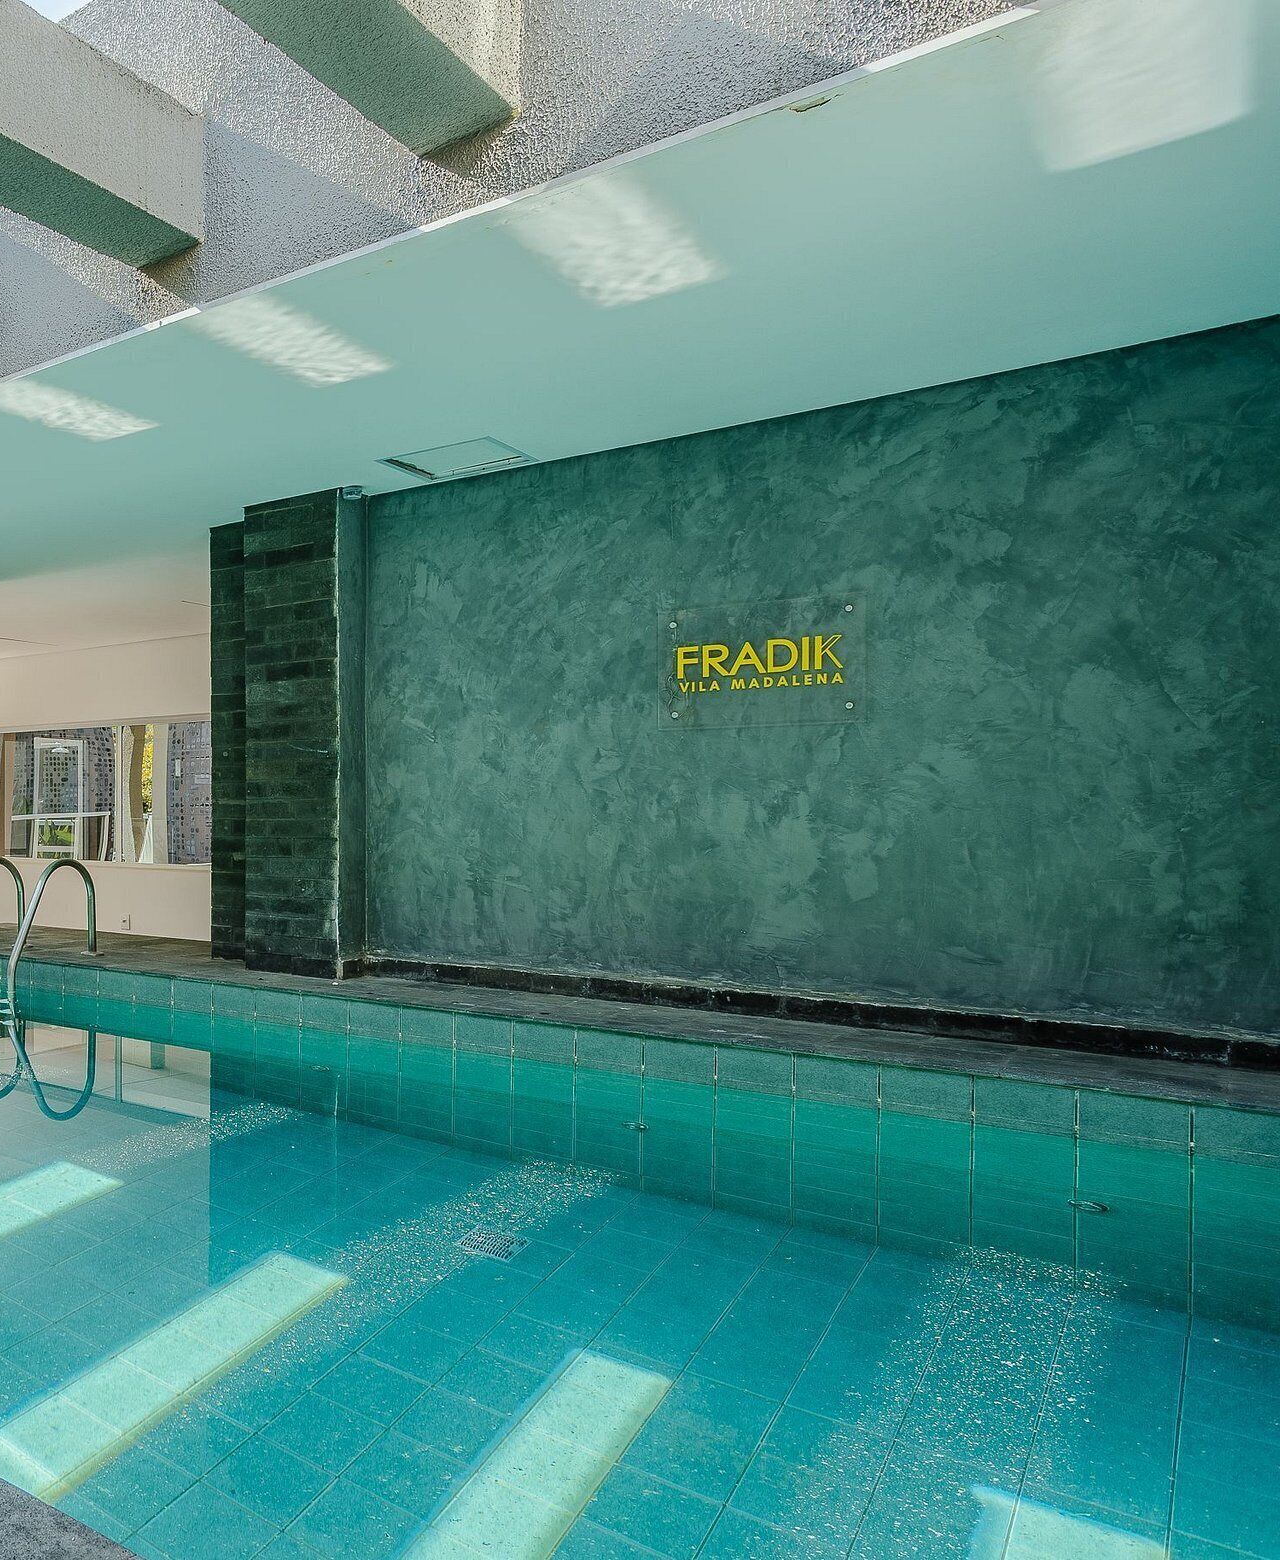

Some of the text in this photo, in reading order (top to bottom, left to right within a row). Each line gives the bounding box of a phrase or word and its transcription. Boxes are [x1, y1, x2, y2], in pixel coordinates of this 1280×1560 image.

[677, 634, 844, 679] FRADIK
[679, 672, 844, 693] VILA MADALENA
